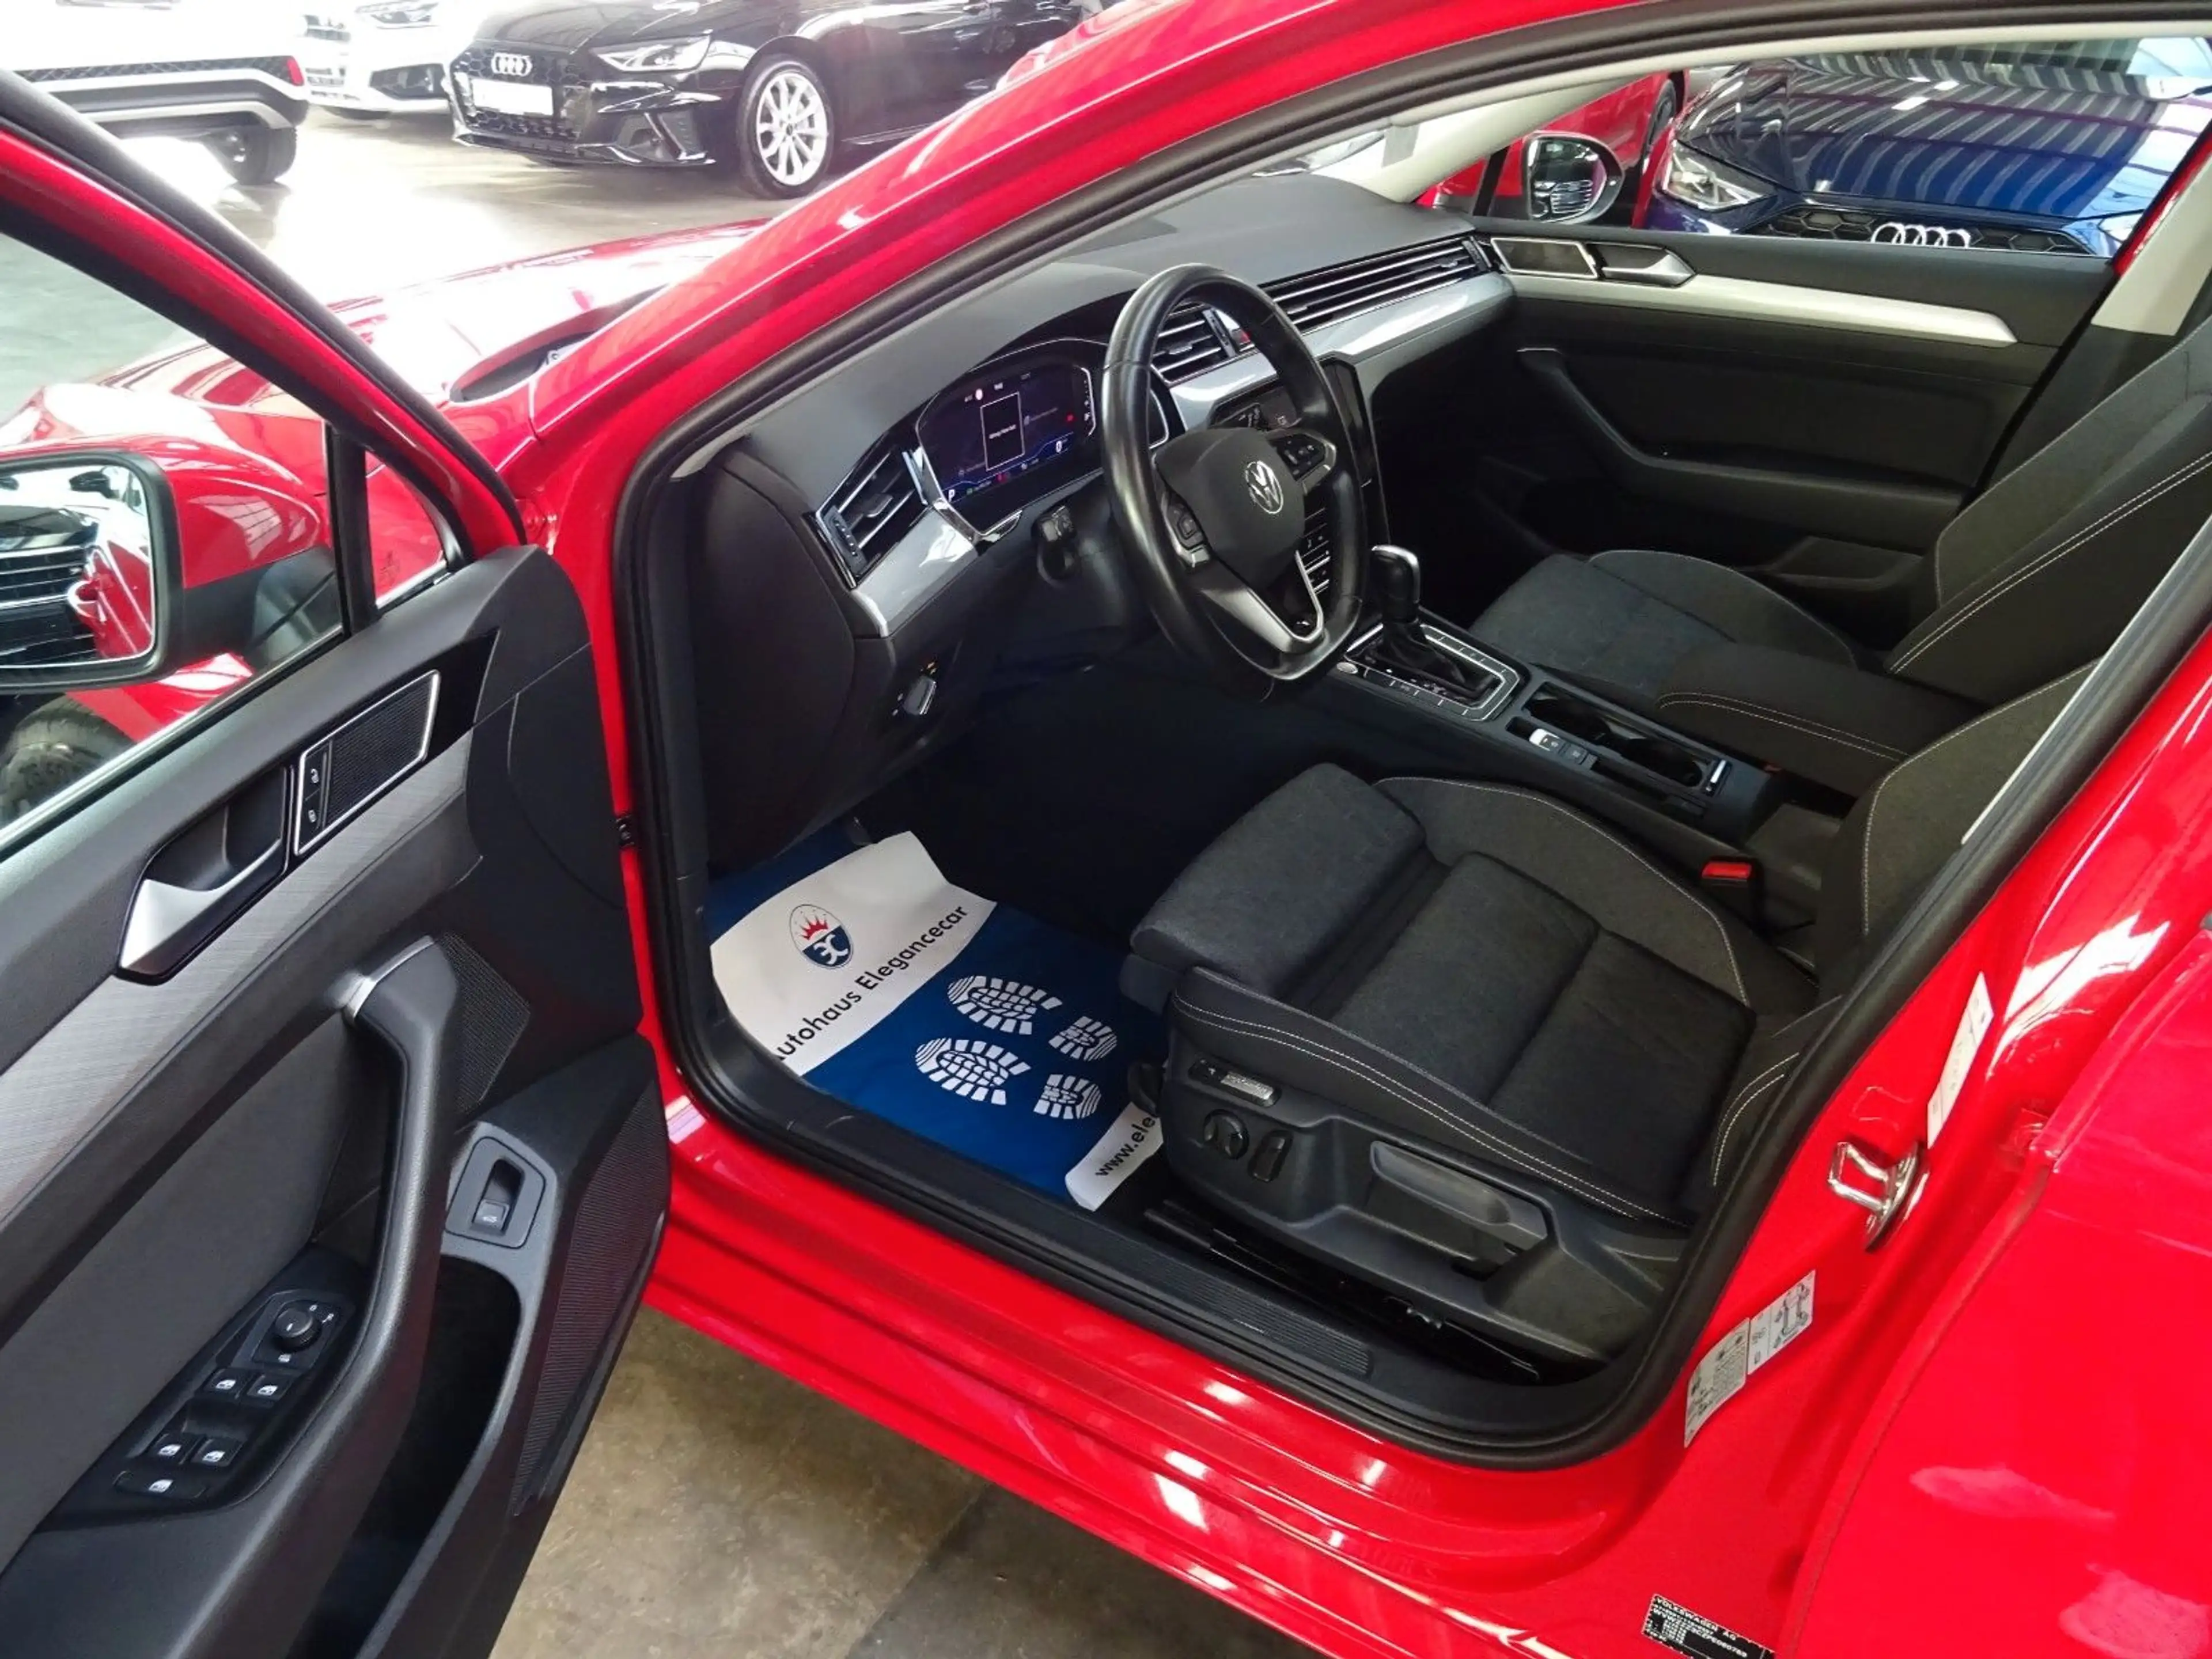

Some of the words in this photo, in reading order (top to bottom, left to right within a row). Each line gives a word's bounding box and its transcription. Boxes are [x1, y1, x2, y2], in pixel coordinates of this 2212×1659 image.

[777, 990, 862, 1060] utohaus
[854, 906, 968, 990] Elegancecar
[1656, 1597, 1718, 1631] VOLKSWAGEN
[1722, 1631, 1737, 1641] AG
